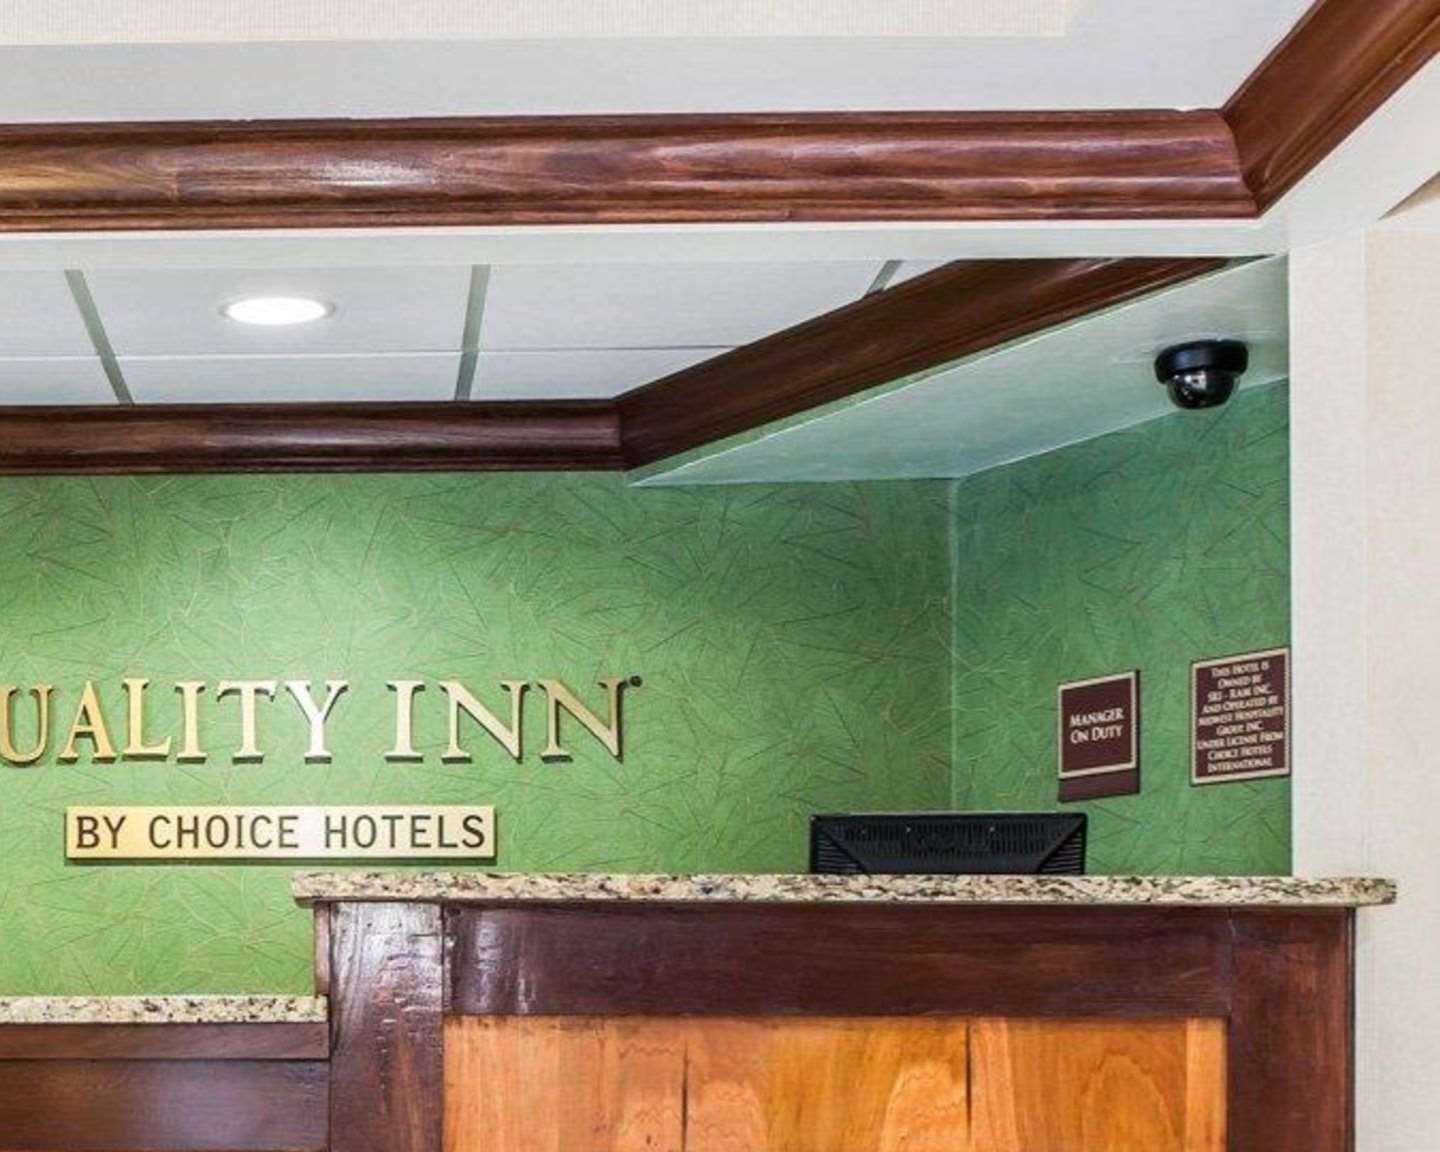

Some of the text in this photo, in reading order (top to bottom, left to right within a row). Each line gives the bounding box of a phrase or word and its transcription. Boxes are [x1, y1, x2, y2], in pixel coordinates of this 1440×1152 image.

[1232, 662, 1260, 675] HOTEL
[1217, 675, 1251, 689] OWNED
[1202, 703, 1221, 715] AND
[1222, 697, 1267, 712] OPERATED
[1069, 707, 1125, 728] MANAGER
[1070, 724, 1124, 744] ON DUTY
[1197, 731, 1284, 750] UNDER LICENSE FROM
[1207, 745, 1273, 761] CHOICE HOTELS
[1207, 757, 1273, 773] INTERNATIONAL
[76, 815, 486, 849] BY CHOICE HOTELS
